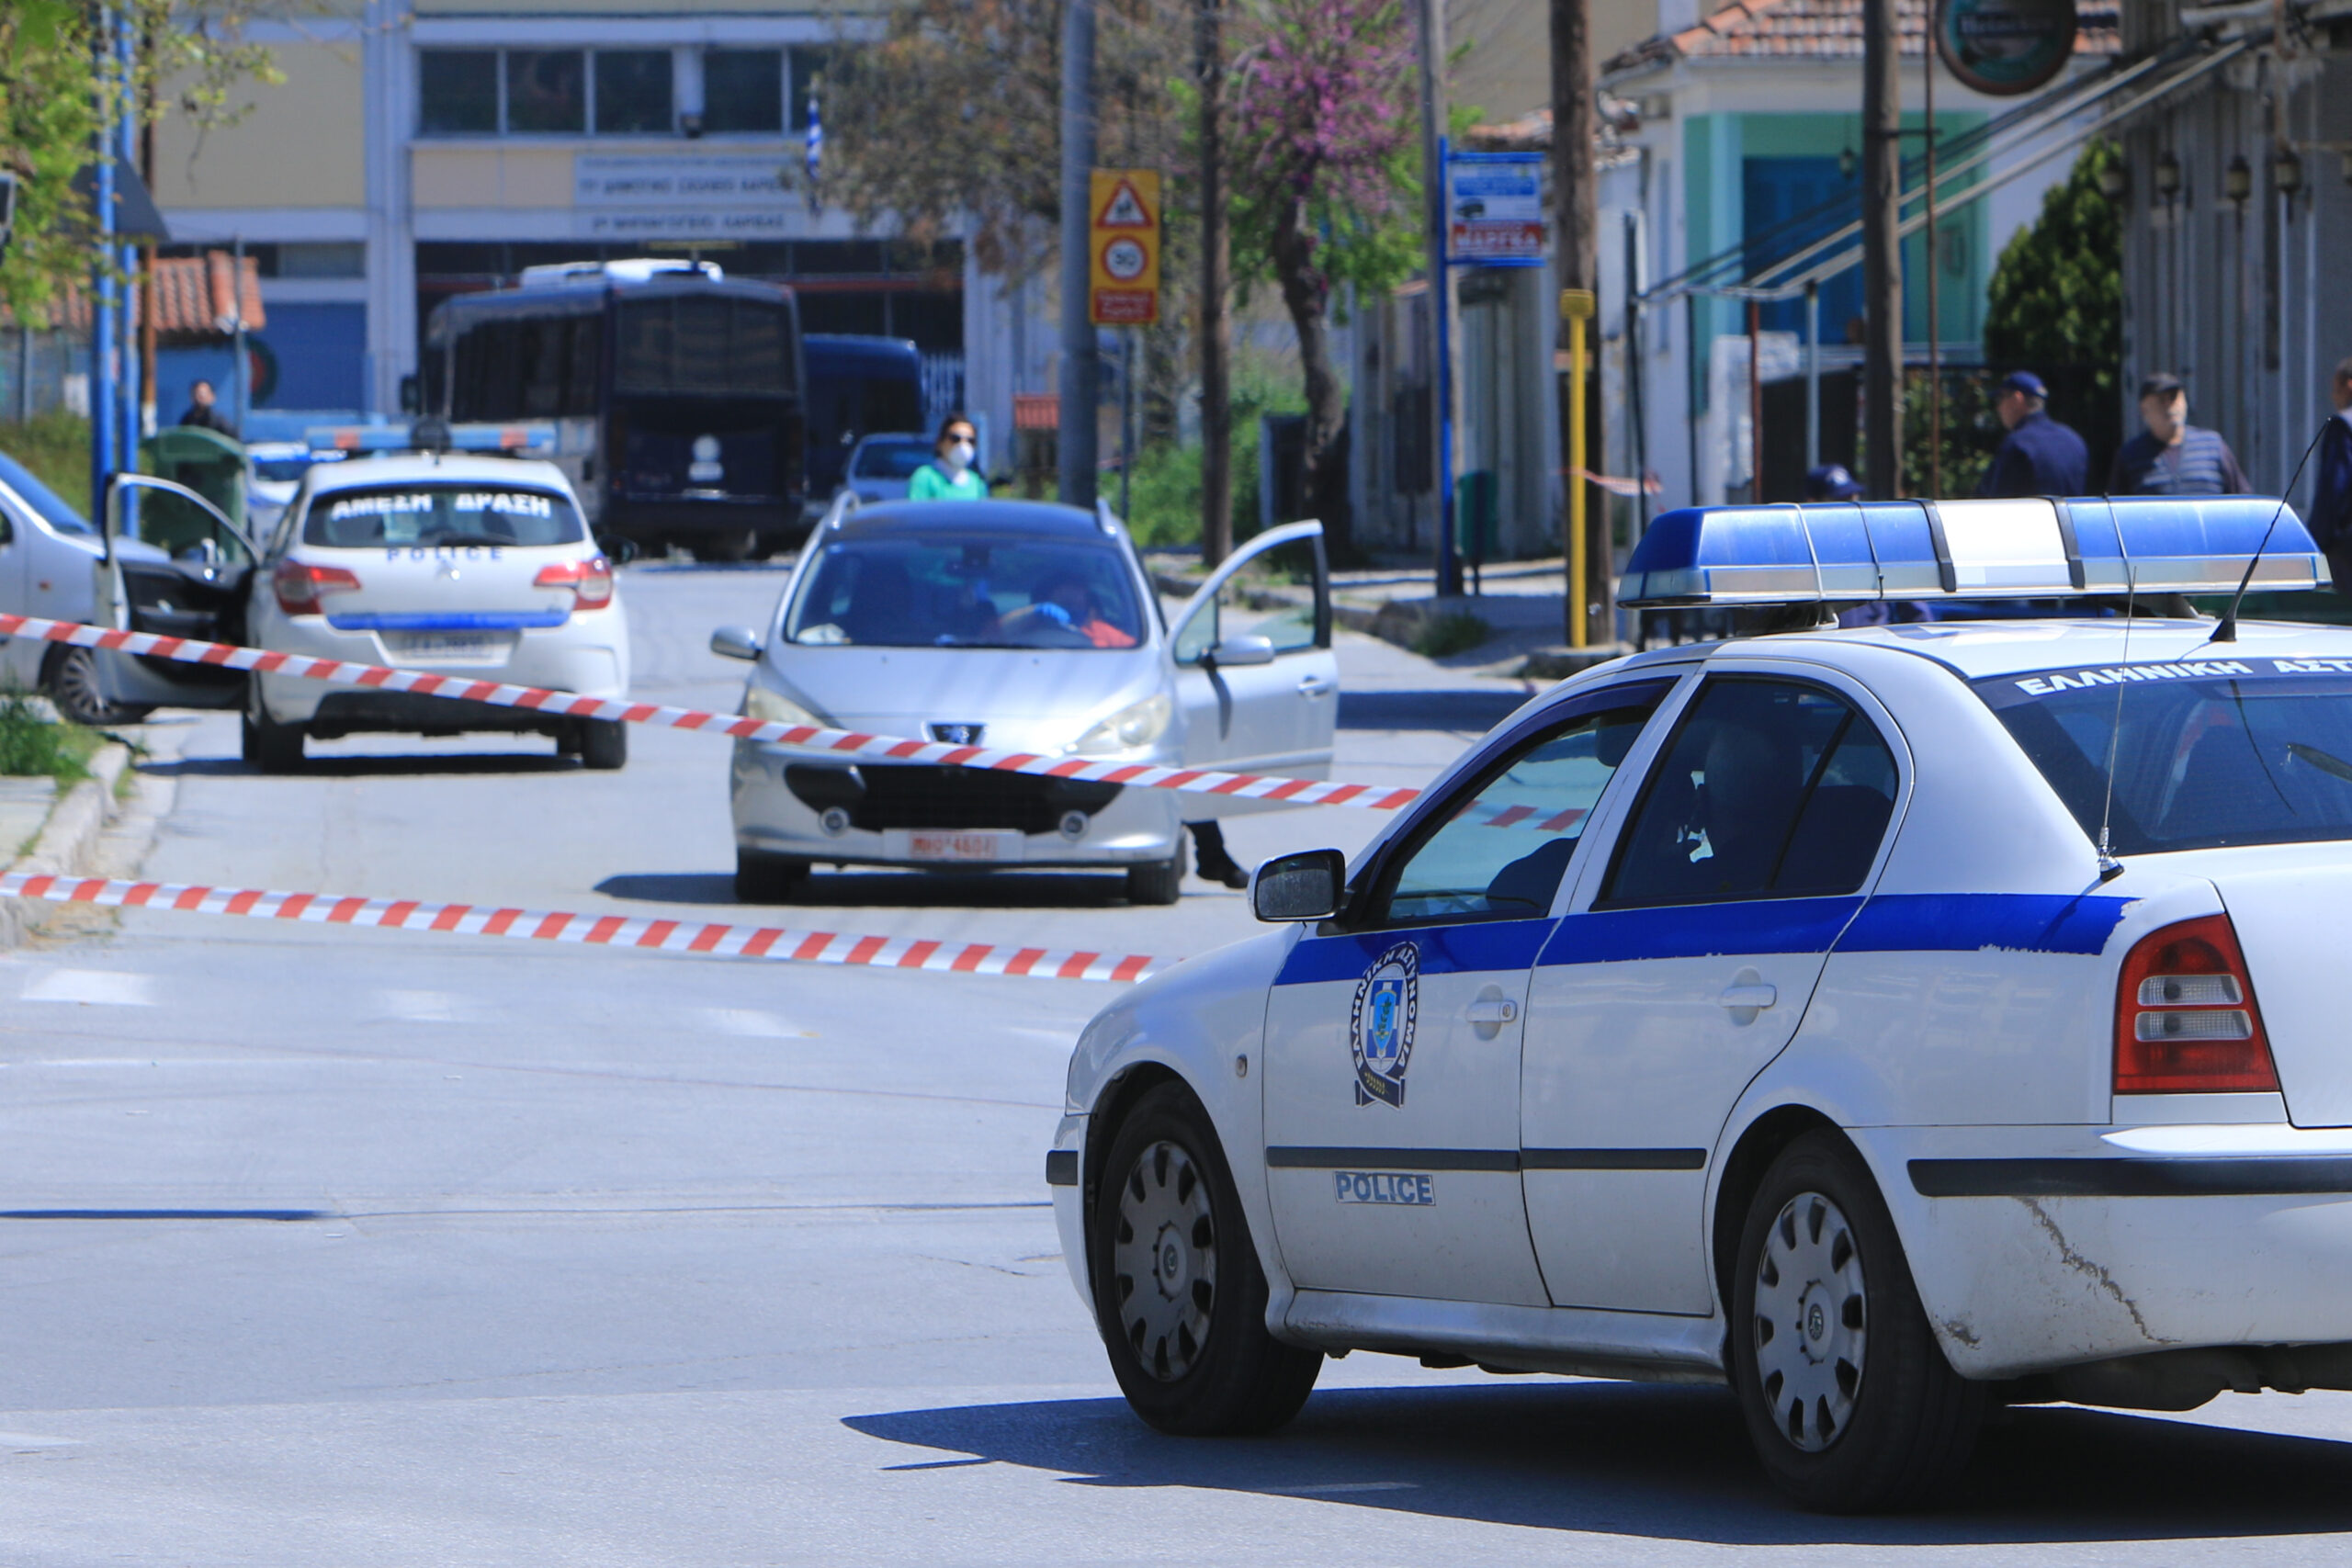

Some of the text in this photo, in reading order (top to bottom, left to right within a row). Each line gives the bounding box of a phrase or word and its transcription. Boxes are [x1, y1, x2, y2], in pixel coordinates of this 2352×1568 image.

[455, 493, 551, 519] ΔΡΑΣΗ
[387, 547, 503, 562] POLICE
[2015, 660, 2352, 696] ΕΛΛΗΝΙΚΗ ΑΣΤ
[1351, 946, 1419, 1071] ΕΛΛΗΝΙΚΗ ΑΣΤΥΝΟΜΙΑ
[1335, 1172, 1433, 1204] POLICE
